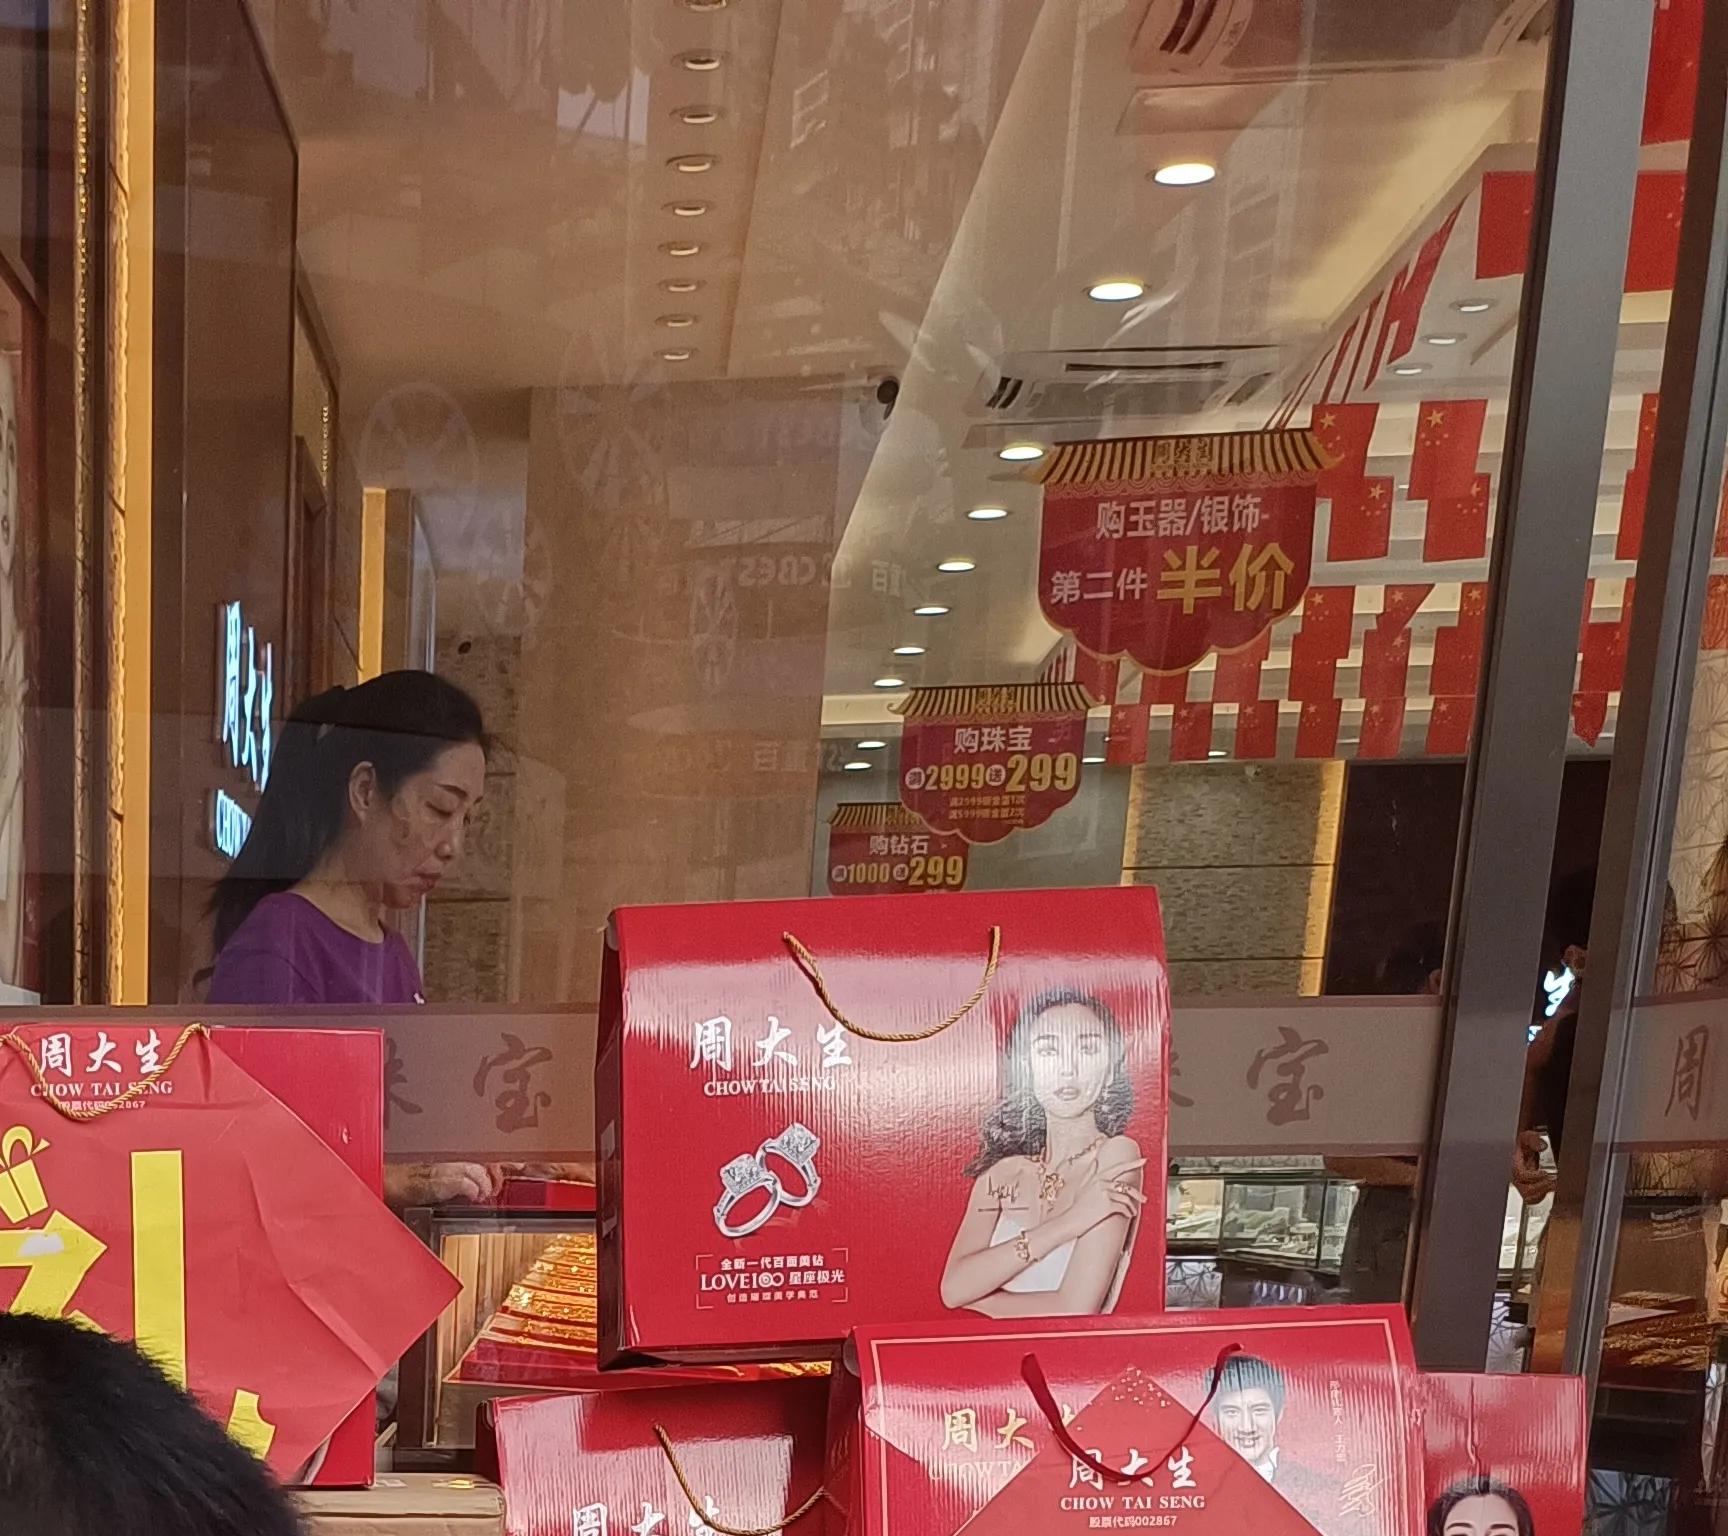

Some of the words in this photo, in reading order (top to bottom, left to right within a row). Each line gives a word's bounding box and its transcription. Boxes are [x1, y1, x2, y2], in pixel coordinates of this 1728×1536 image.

[1096, 495, 1262, 539] 购玉器/银饰
[1050, 567, 1148, 605] 第二件
[1157, 543, 1295, 614] 半价
[954, 725, 1033, 753] 购珠宝
[869, 835, 930, 855] 购钻石
[39, 1028, 165, 1077] 周大生
[690, 1015, 852, 1071] 周大生
[91, 1082, 121, 1096] TAI
[1069, 1446, 1197, 1490] 周大生
[1060, 1496, 1114, 1511] CHOW
[1122, 1496, 1152, 1510] TAI
[1159, 1495, 1205, 1509] SENG
